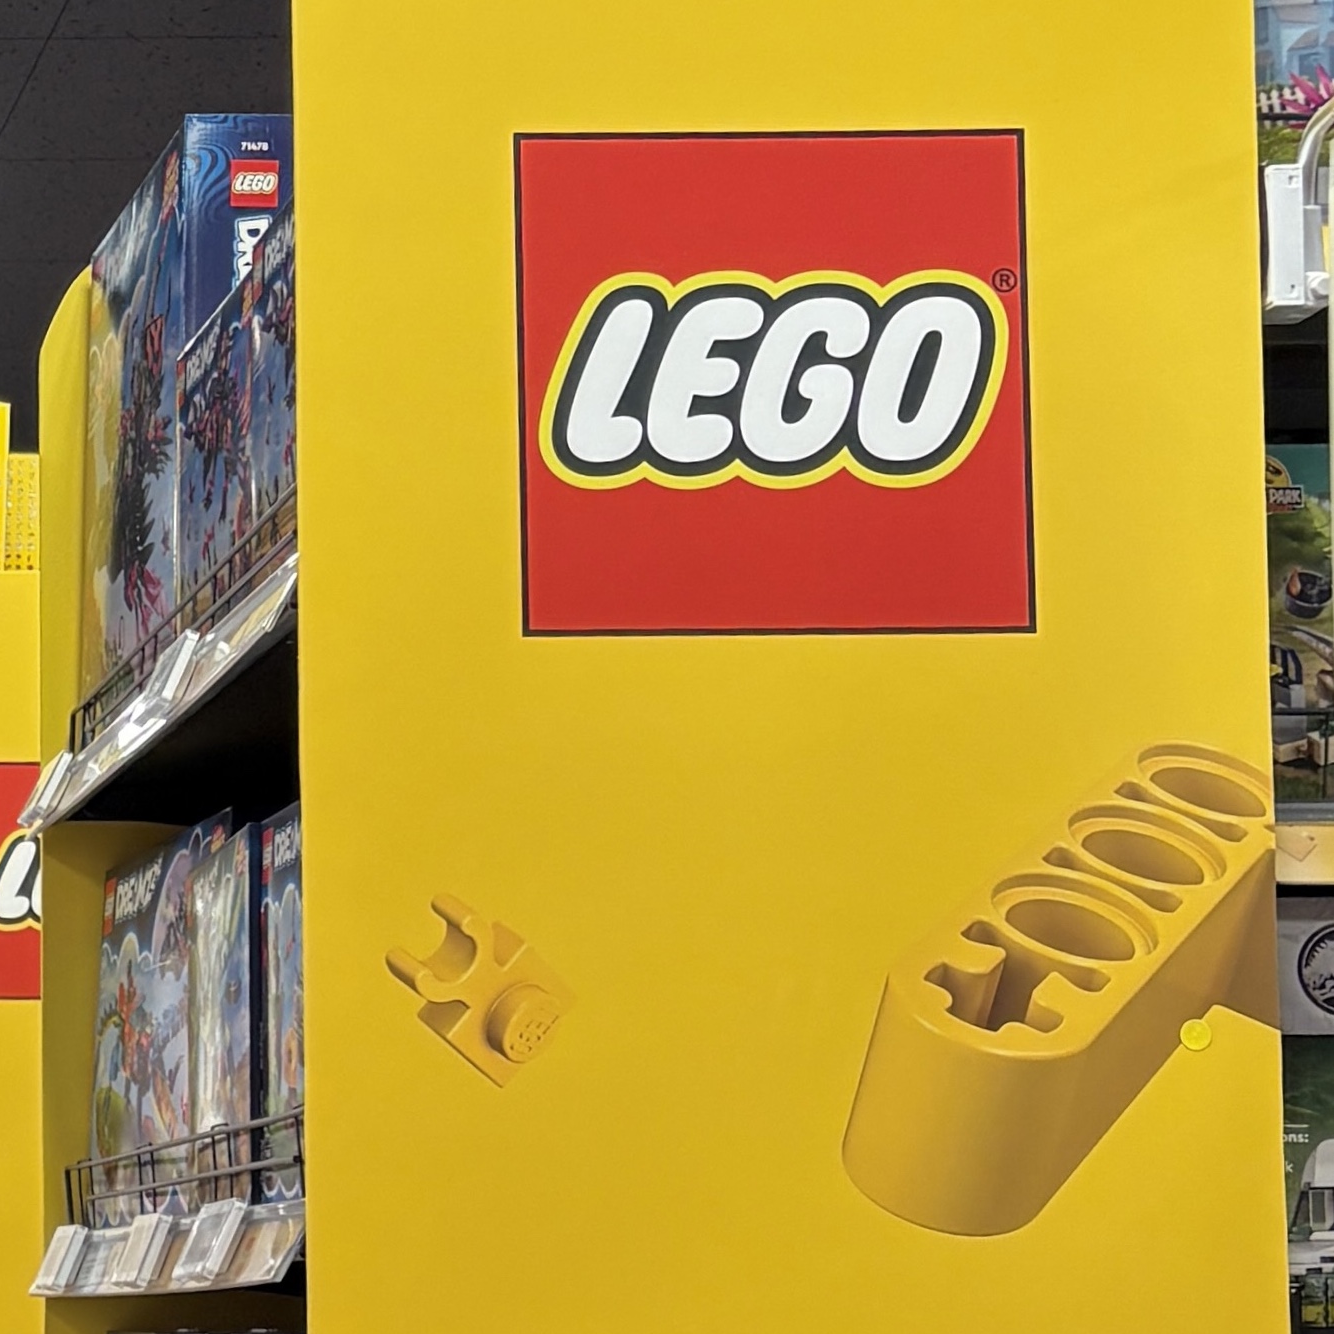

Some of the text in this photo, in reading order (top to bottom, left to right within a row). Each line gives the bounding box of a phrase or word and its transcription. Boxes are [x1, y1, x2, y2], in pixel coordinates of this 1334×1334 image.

[233, 173, 277, 194] LEGO
[551, 283, 997, 480] LEGO
[1269, 489, 1302, 505] PARK
